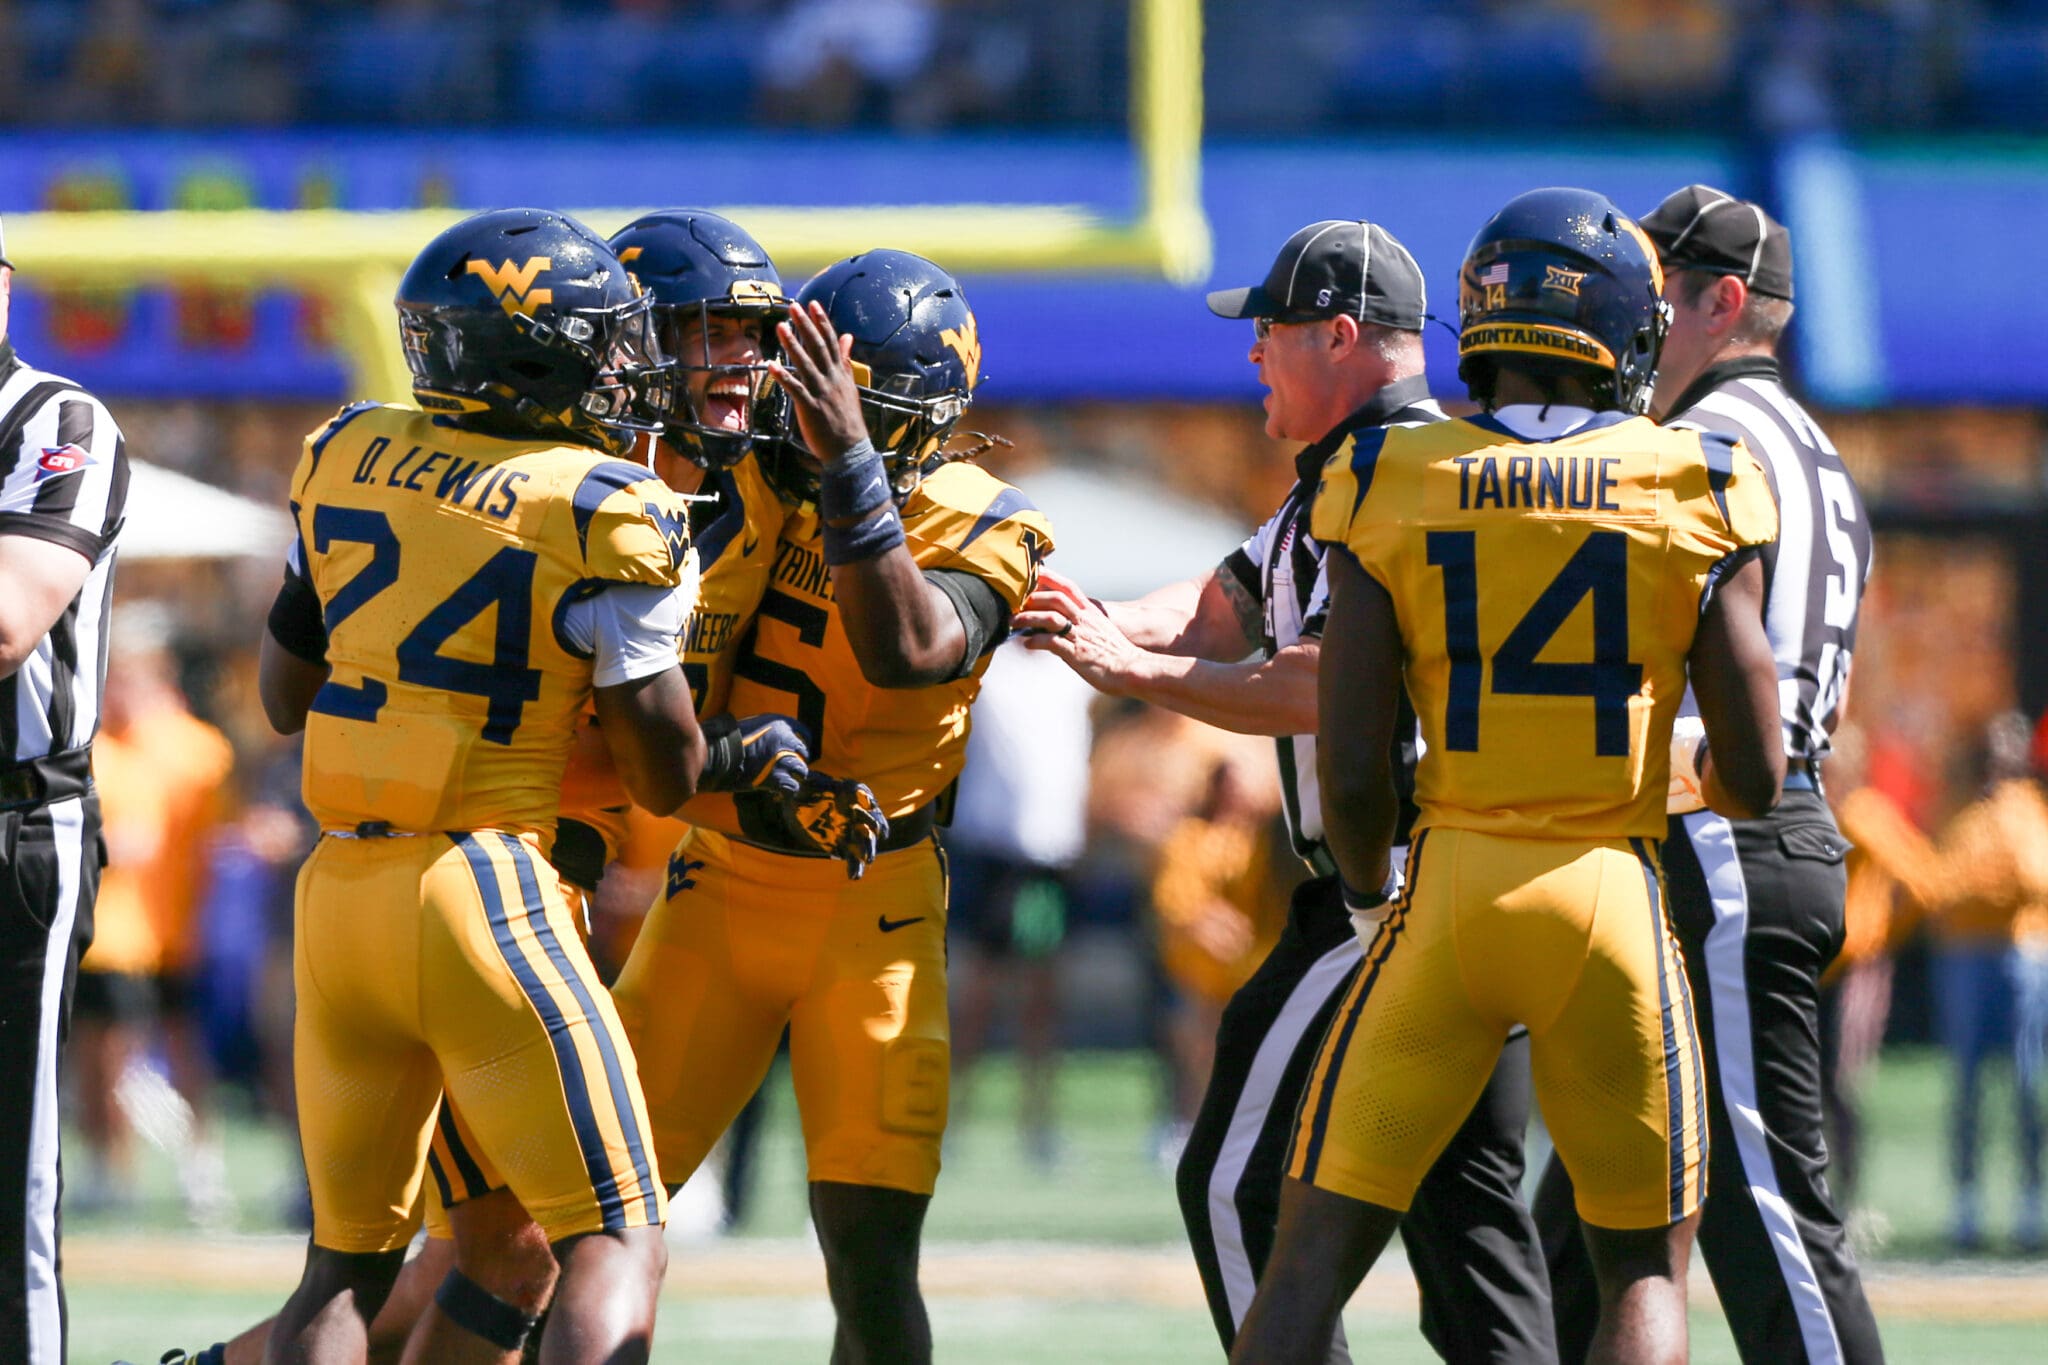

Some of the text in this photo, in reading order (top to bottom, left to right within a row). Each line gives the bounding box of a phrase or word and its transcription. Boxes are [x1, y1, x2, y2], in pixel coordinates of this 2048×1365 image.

[1316, 289, 1332, 307] S
[1486, 284, 1507, 310] 14
[1461, 328, 1600, 359] MOUNTAINEERS
[386, 446, 530, 521] LEWIS
[1453, 456, 1621, 511] TARNUE
[770, 536, 834, 602] TAINE
[308, 503, 543, 746] 24
[676, 612, 739, 654] NEERS
[1426, 530, 1643, 757] 14
[733, 587, 829, 761] 5
